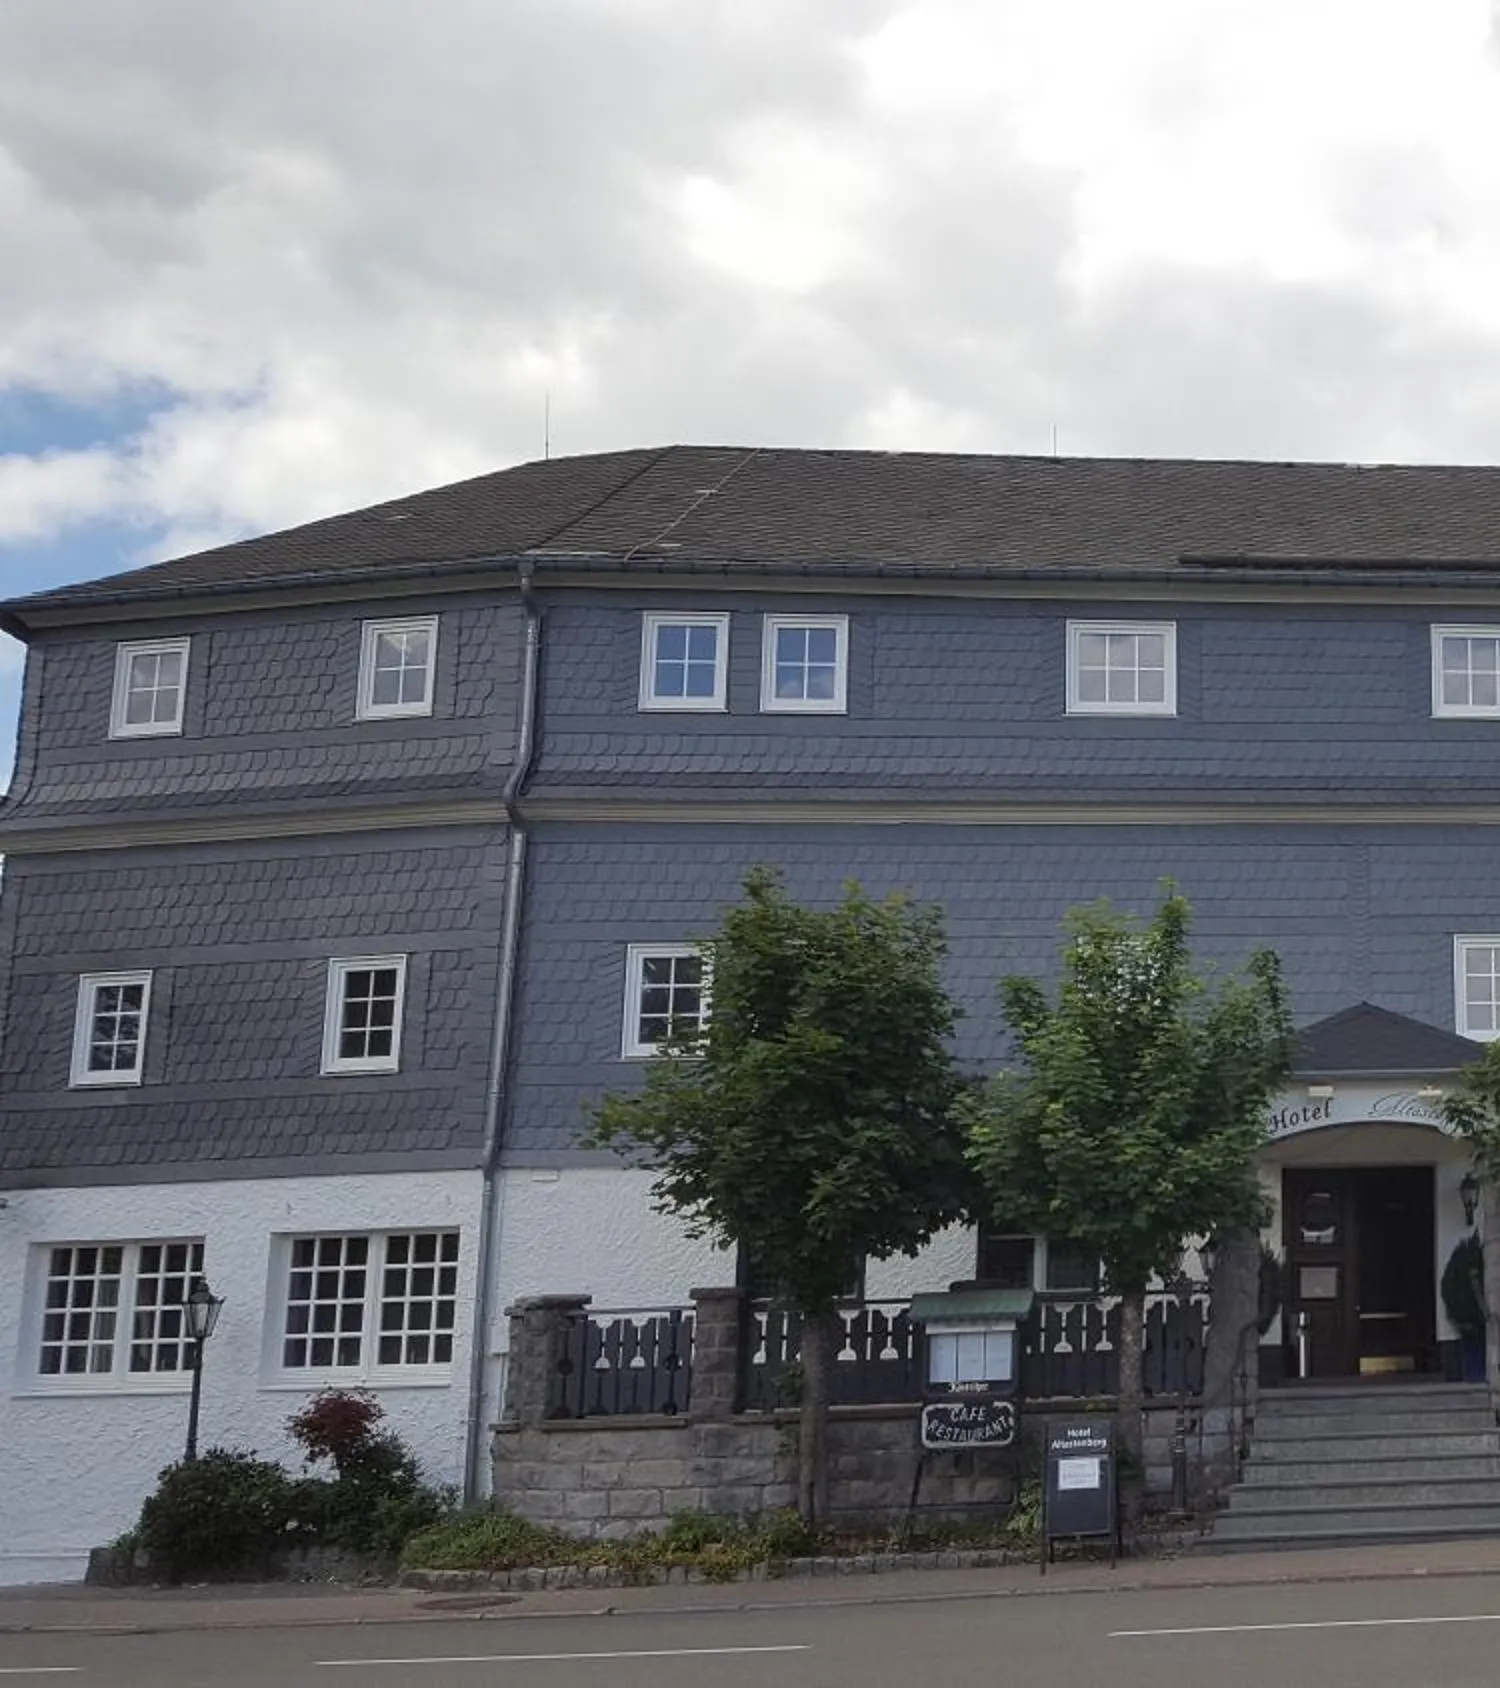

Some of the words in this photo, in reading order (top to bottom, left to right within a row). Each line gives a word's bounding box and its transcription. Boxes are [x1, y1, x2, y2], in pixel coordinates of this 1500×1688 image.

[1271, 1097, 1334, 1134] Hotel
[927, 1415, 1009, 1441] RESTAURANT
[1067, 1427, 1091, 1438] Hotel
